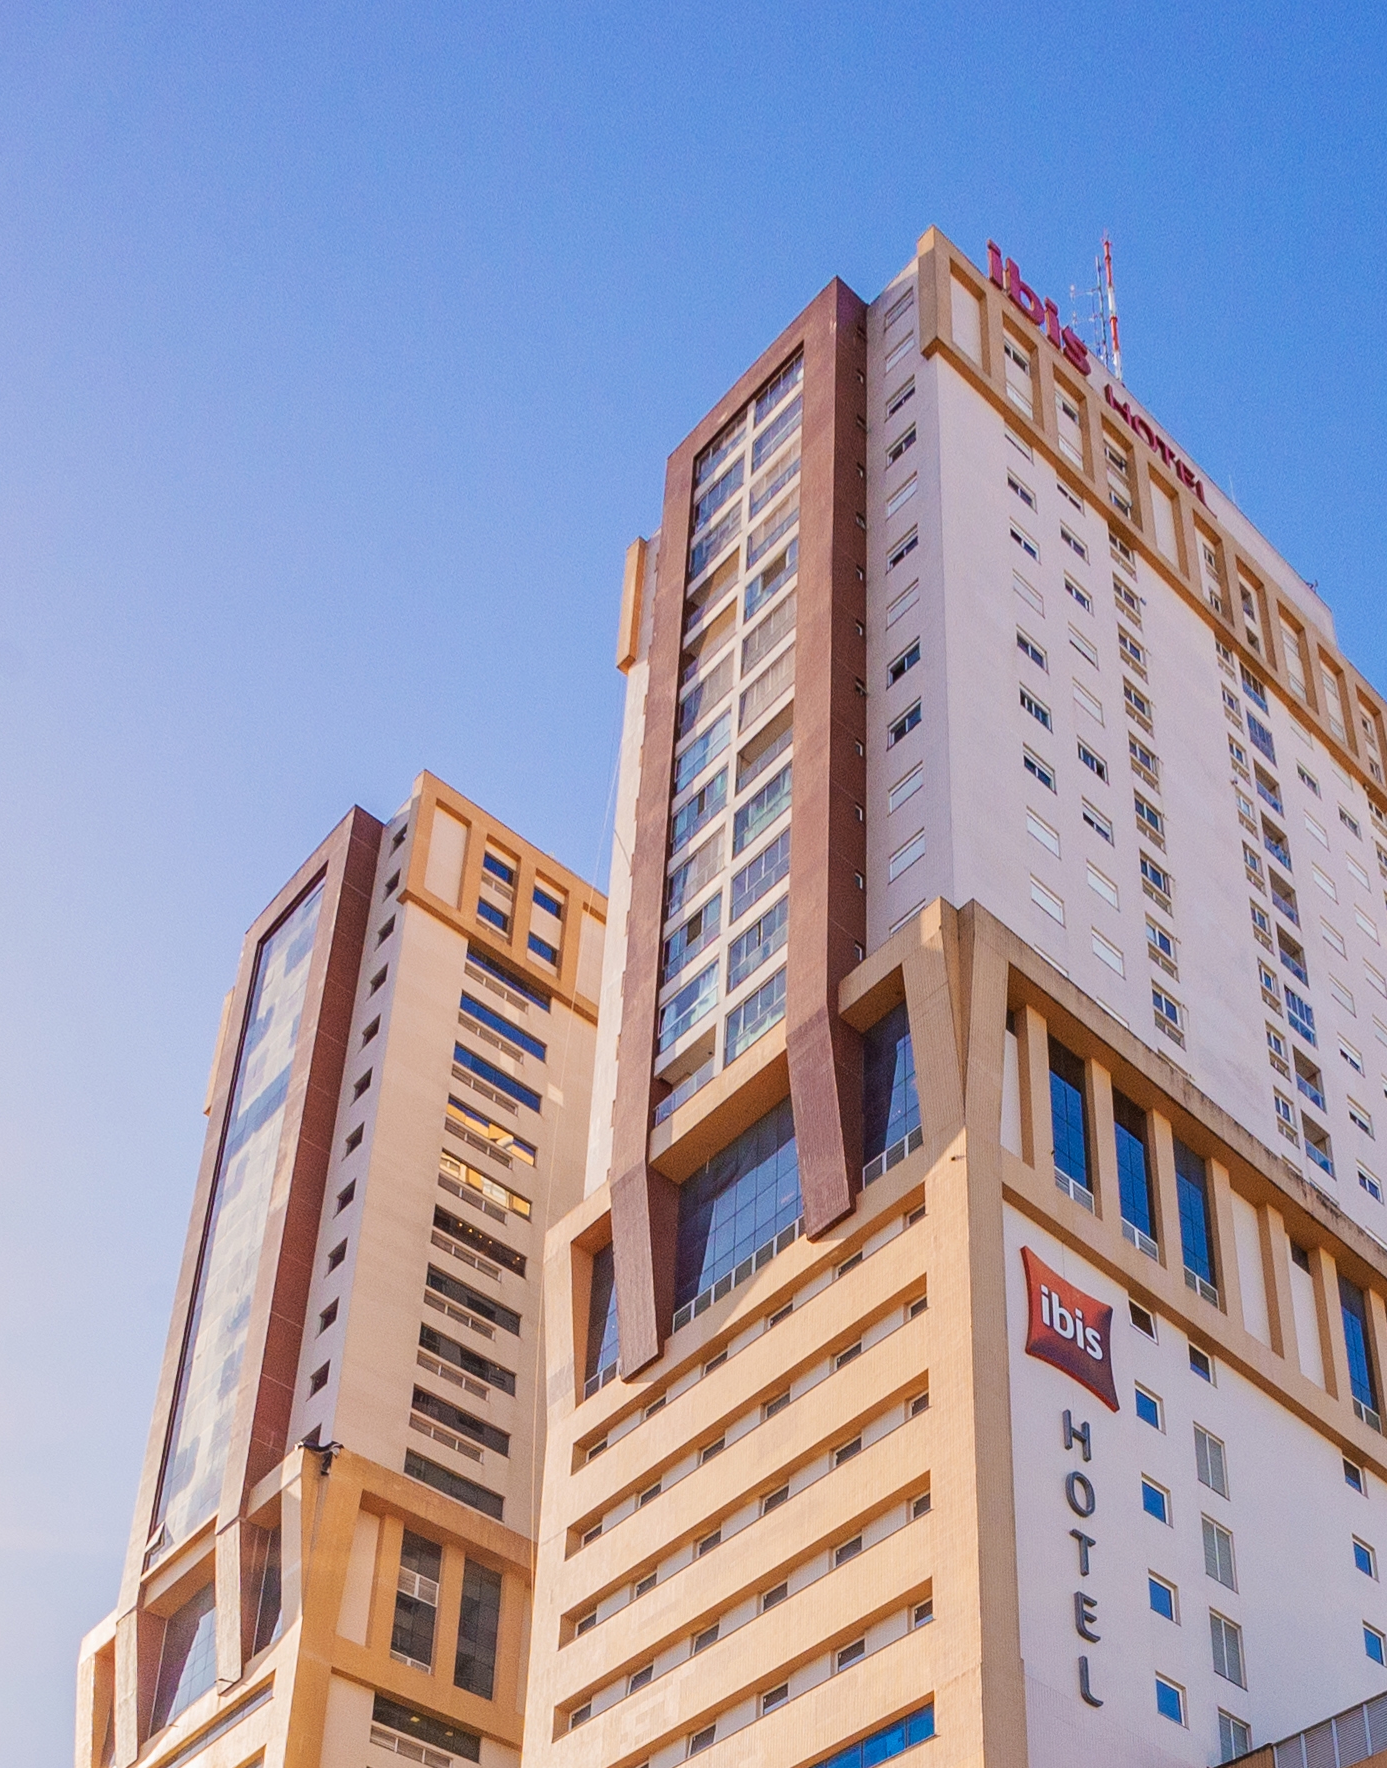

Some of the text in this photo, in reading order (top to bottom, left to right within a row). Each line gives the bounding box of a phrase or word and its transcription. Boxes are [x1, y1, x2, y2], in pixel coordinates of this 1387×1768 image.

[987, 239, 1218, 519] ibis HOTEL
[1040, 1285, 1103, 1361] ibis
[1062, 1409, 1104, 1708] HOTEL
